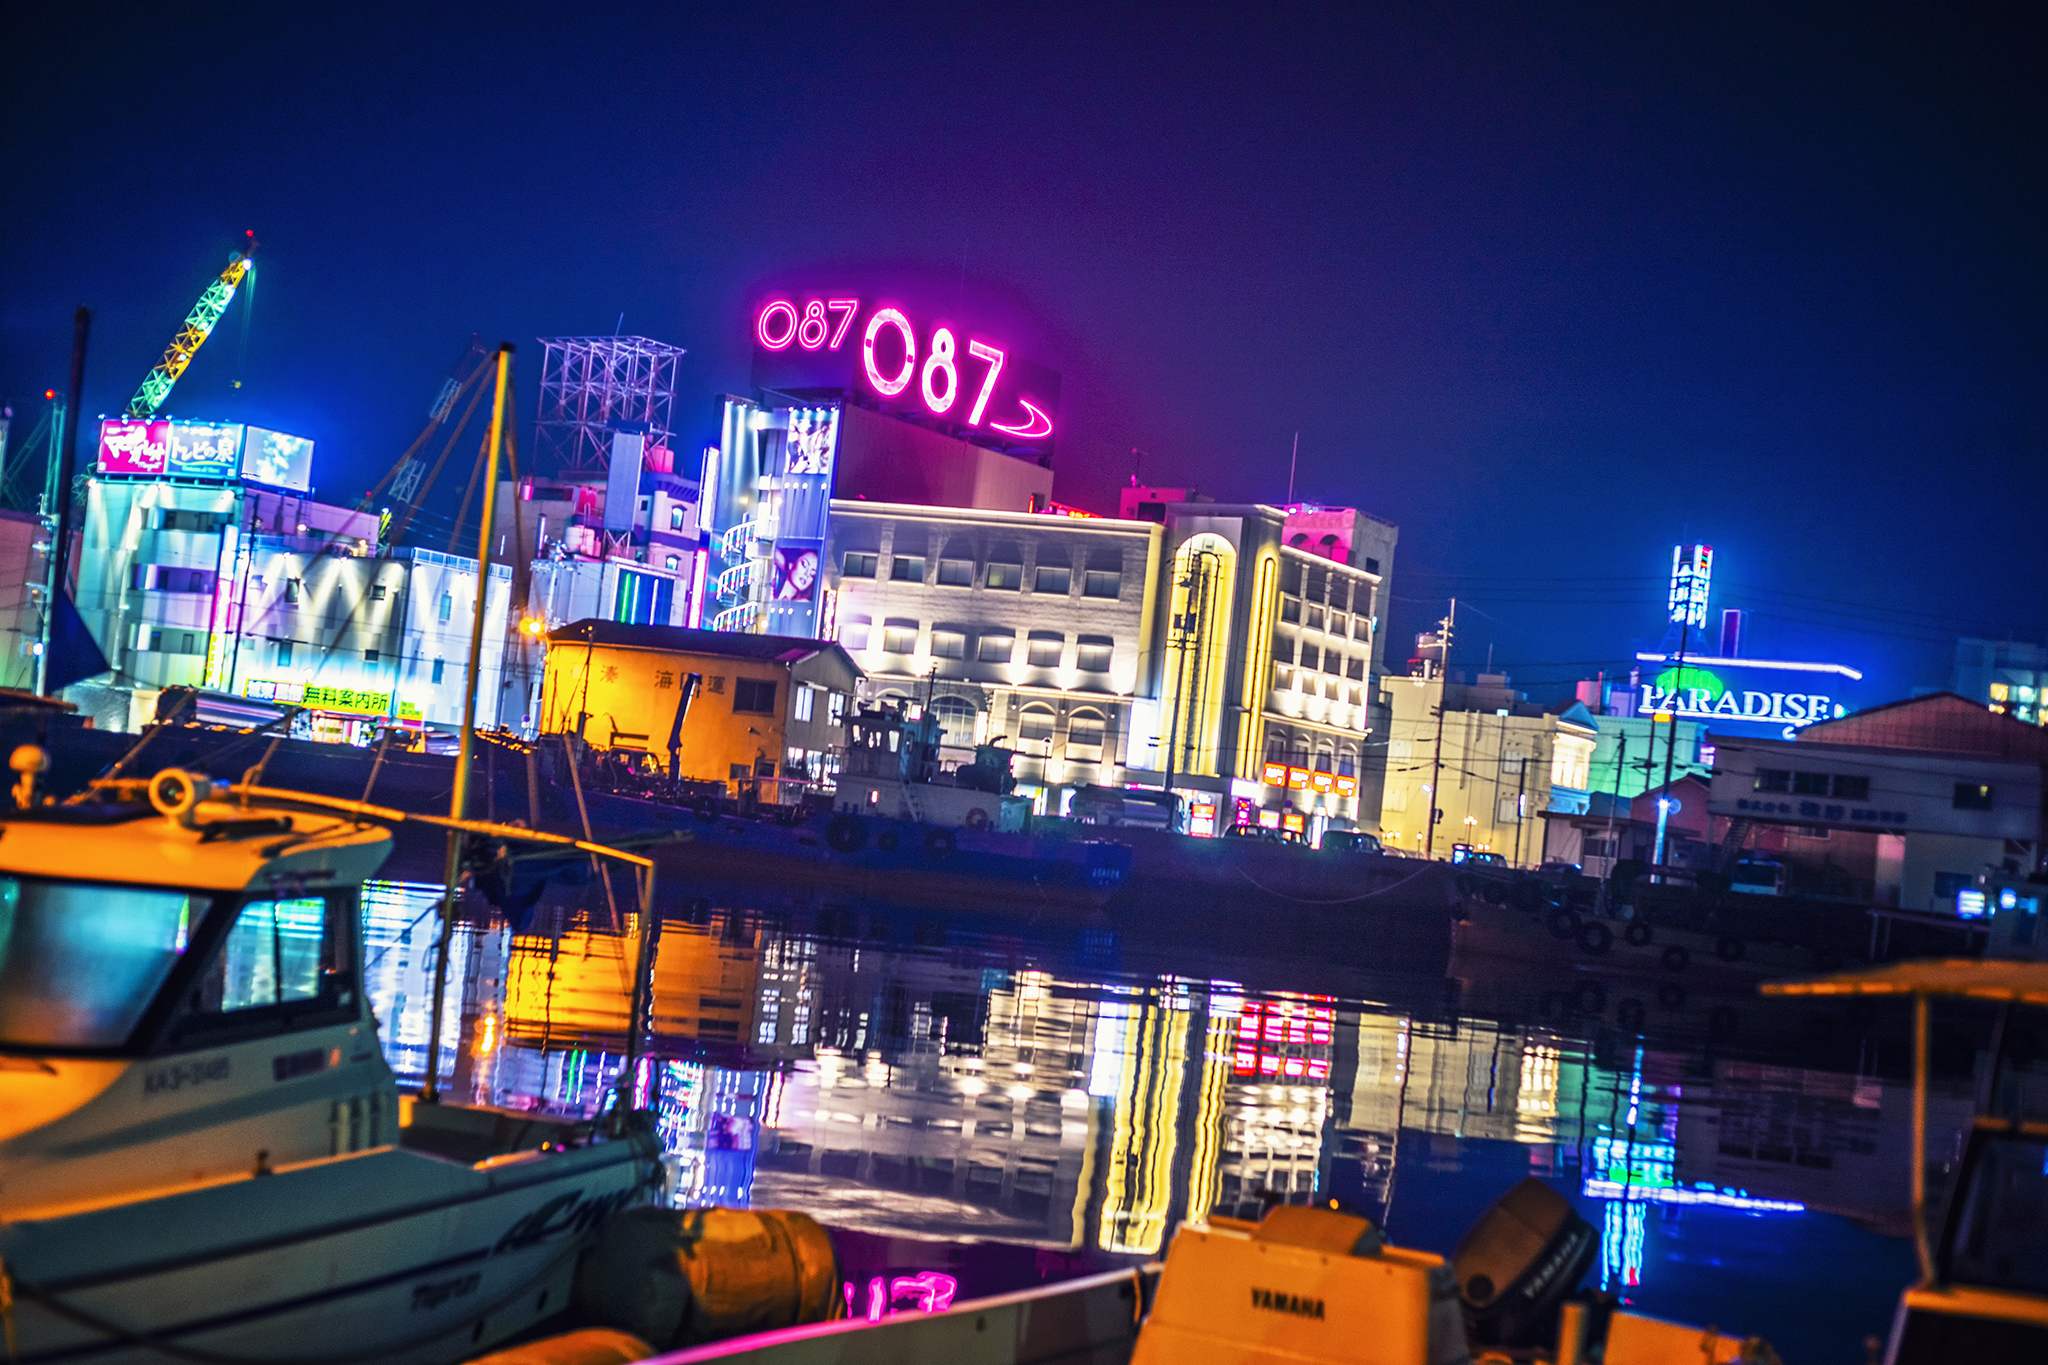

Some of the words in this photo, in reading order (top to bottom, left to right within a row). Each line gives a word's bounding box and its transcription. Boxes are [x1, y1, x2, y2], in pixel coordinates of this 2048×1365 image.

[757, 298, 860, 350] 087
[863, 307, 1005, 427] 087
[171, 436, 235, 462] トレビの泉
[303, 686, 389, 712] 無料案内所
[1640, 683, 1831, 721] PARADISE
[1523, 1231, 1579, 1299] YAMAHA
[1250, 1288, 1326, 1322] YAMAHA
